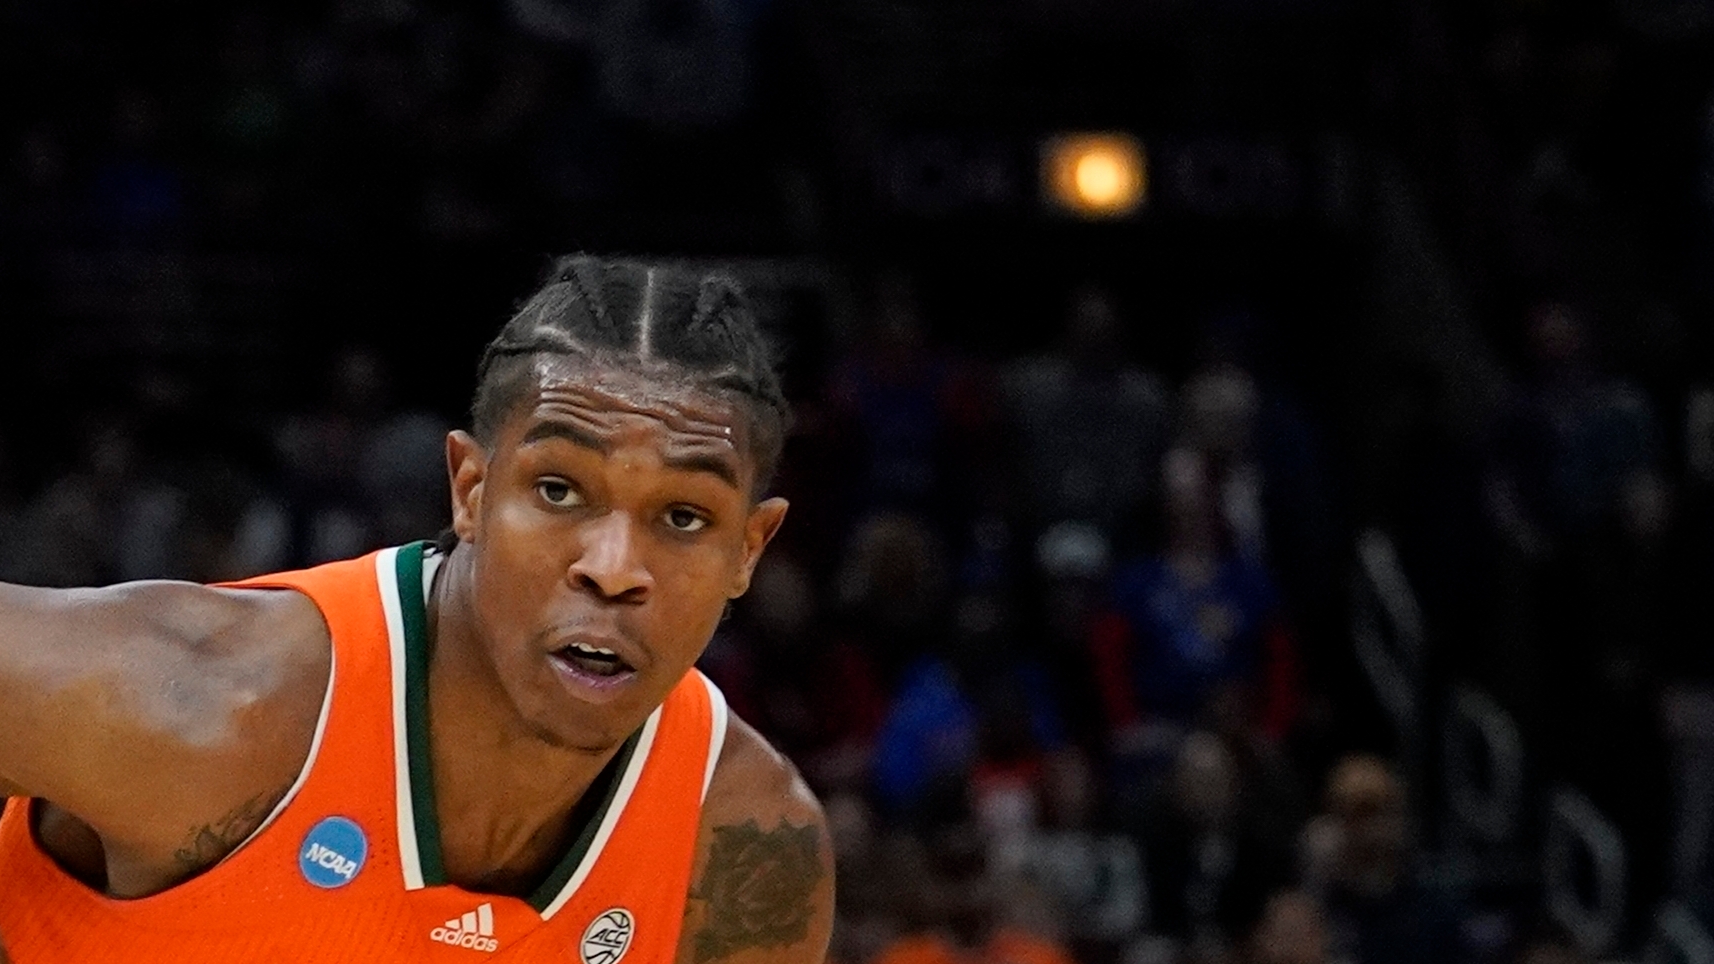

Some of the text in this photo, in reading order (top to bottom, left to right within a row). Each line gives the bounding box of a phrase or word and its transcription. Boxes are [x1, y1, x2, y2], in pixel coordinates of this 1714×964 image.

[305, 842, 357, 880] NCAA
[430, 926, 499, 953] adidas
[589, 928, 628, 945] ACC
